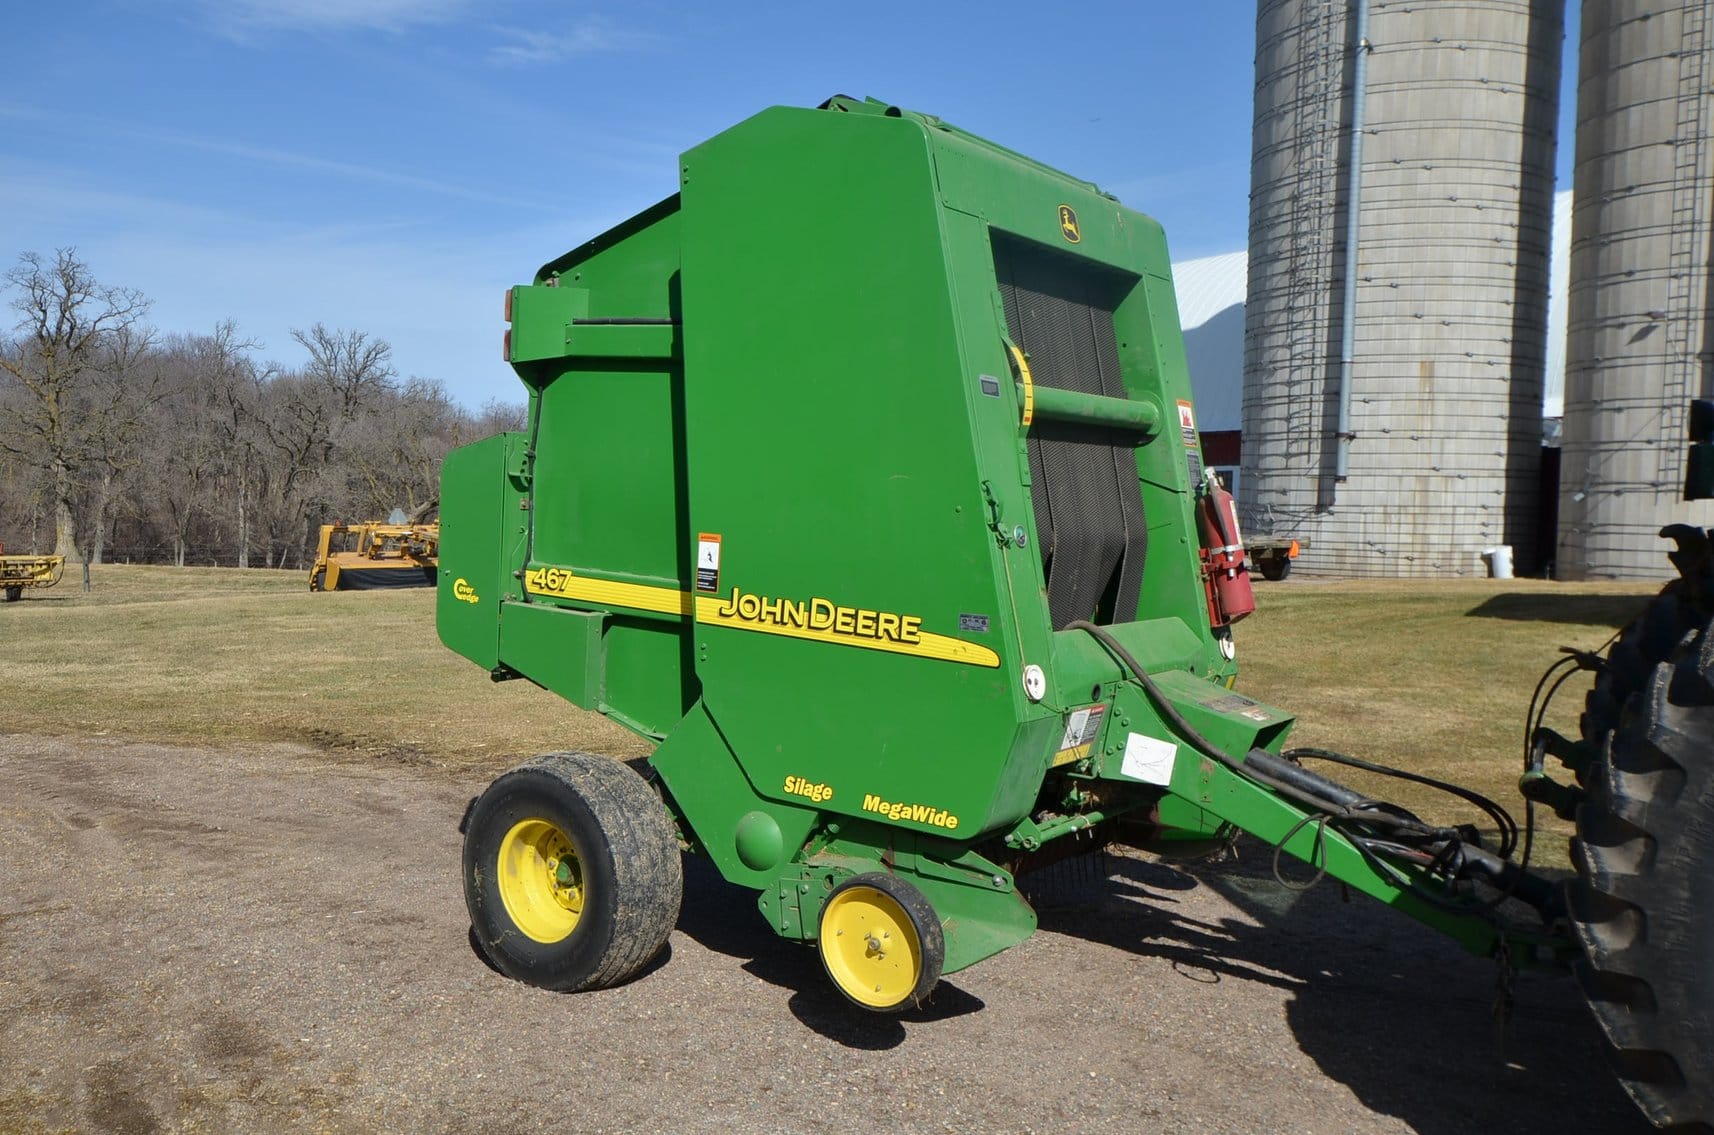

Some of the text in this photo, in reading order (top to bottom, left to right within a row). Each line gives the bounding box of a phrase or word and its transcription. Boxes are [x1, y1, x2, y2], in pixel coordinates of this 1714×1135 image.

[532, 568, 572, 591] 467
[719, 587, 804, 627] JOHN
[809, 597, 922, 645] DEERE
[784, 775, 833, 802] Silage
[863, 794, 958, 829] MegaWide
